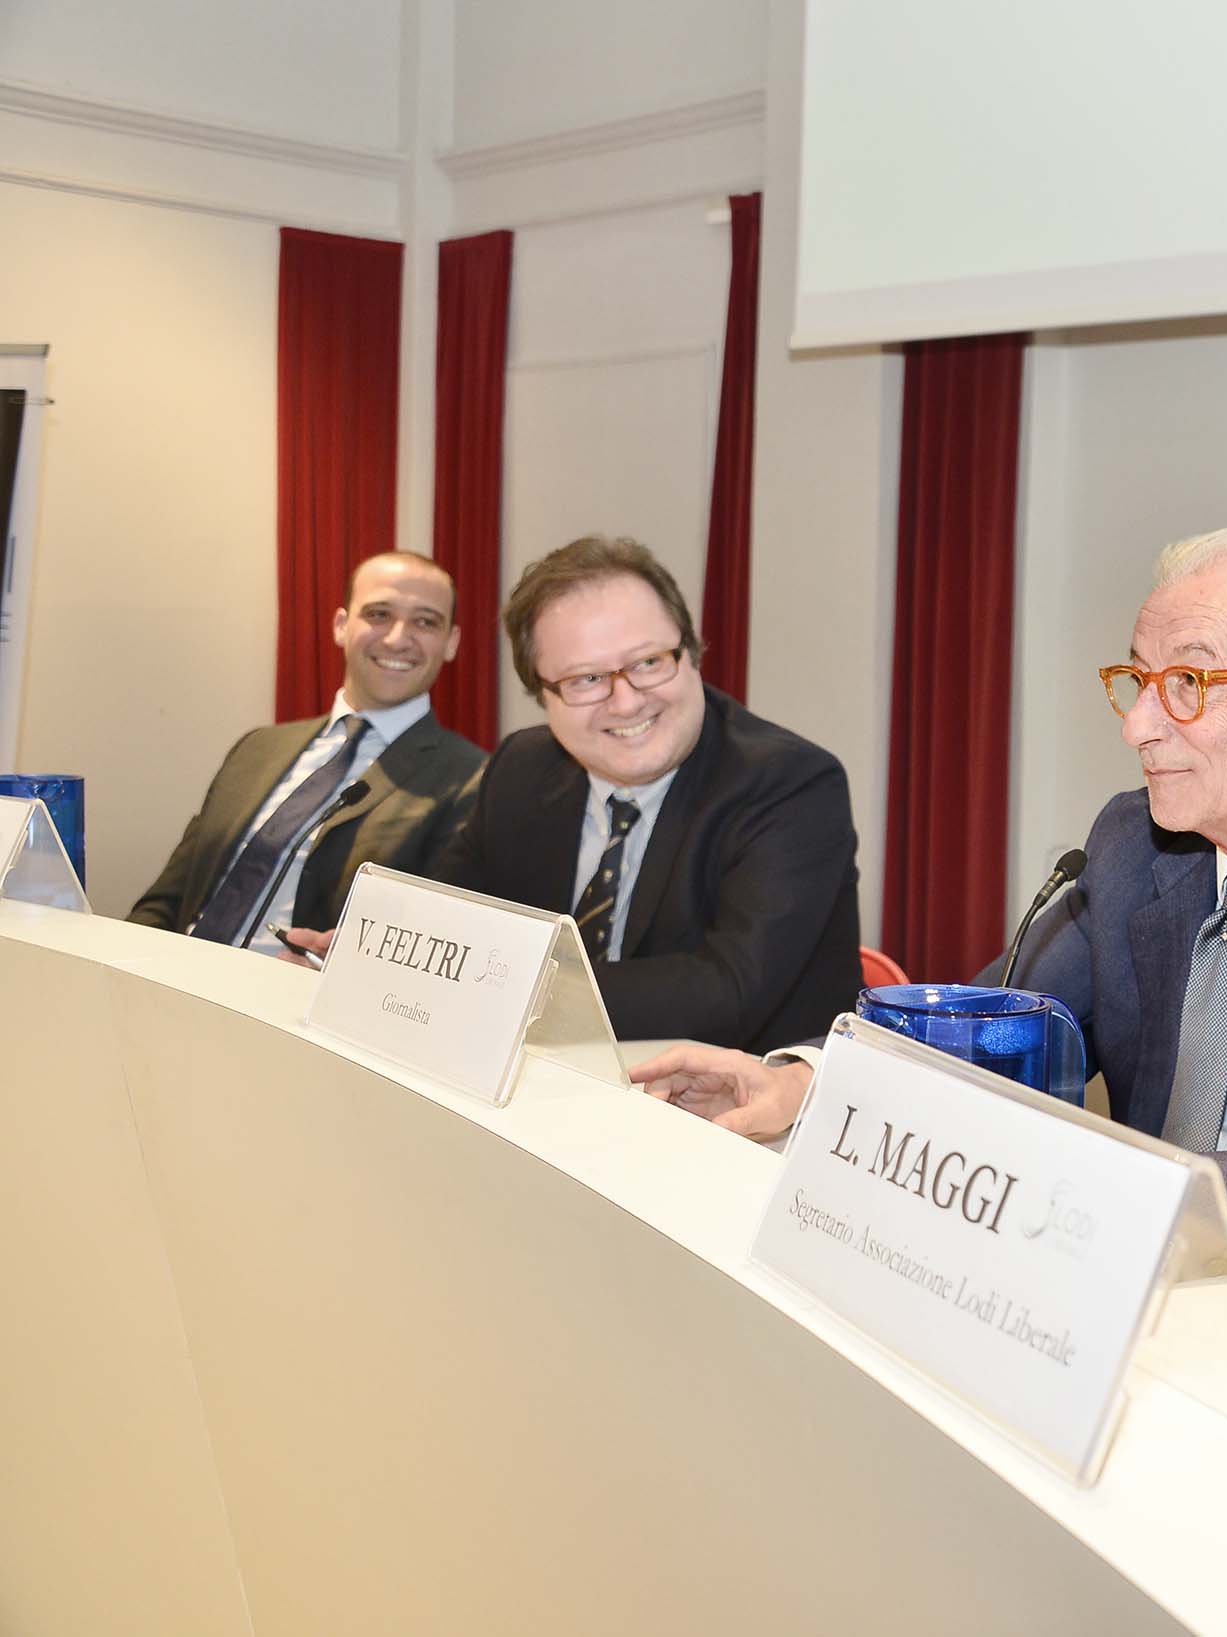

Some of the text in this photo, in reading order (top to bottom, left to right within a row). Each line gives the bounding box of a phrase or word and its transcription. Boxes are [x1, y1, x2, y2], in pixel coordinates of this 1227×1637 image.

[357, 917, 472, 983] V. FELTRI
[381, 992, 432, 1026] Giornalista
[830, 1104, 1019, 1234] L. MAGGI
[789, 1187, 1077, 1369] Segretario Associazione Lodi Liberale
